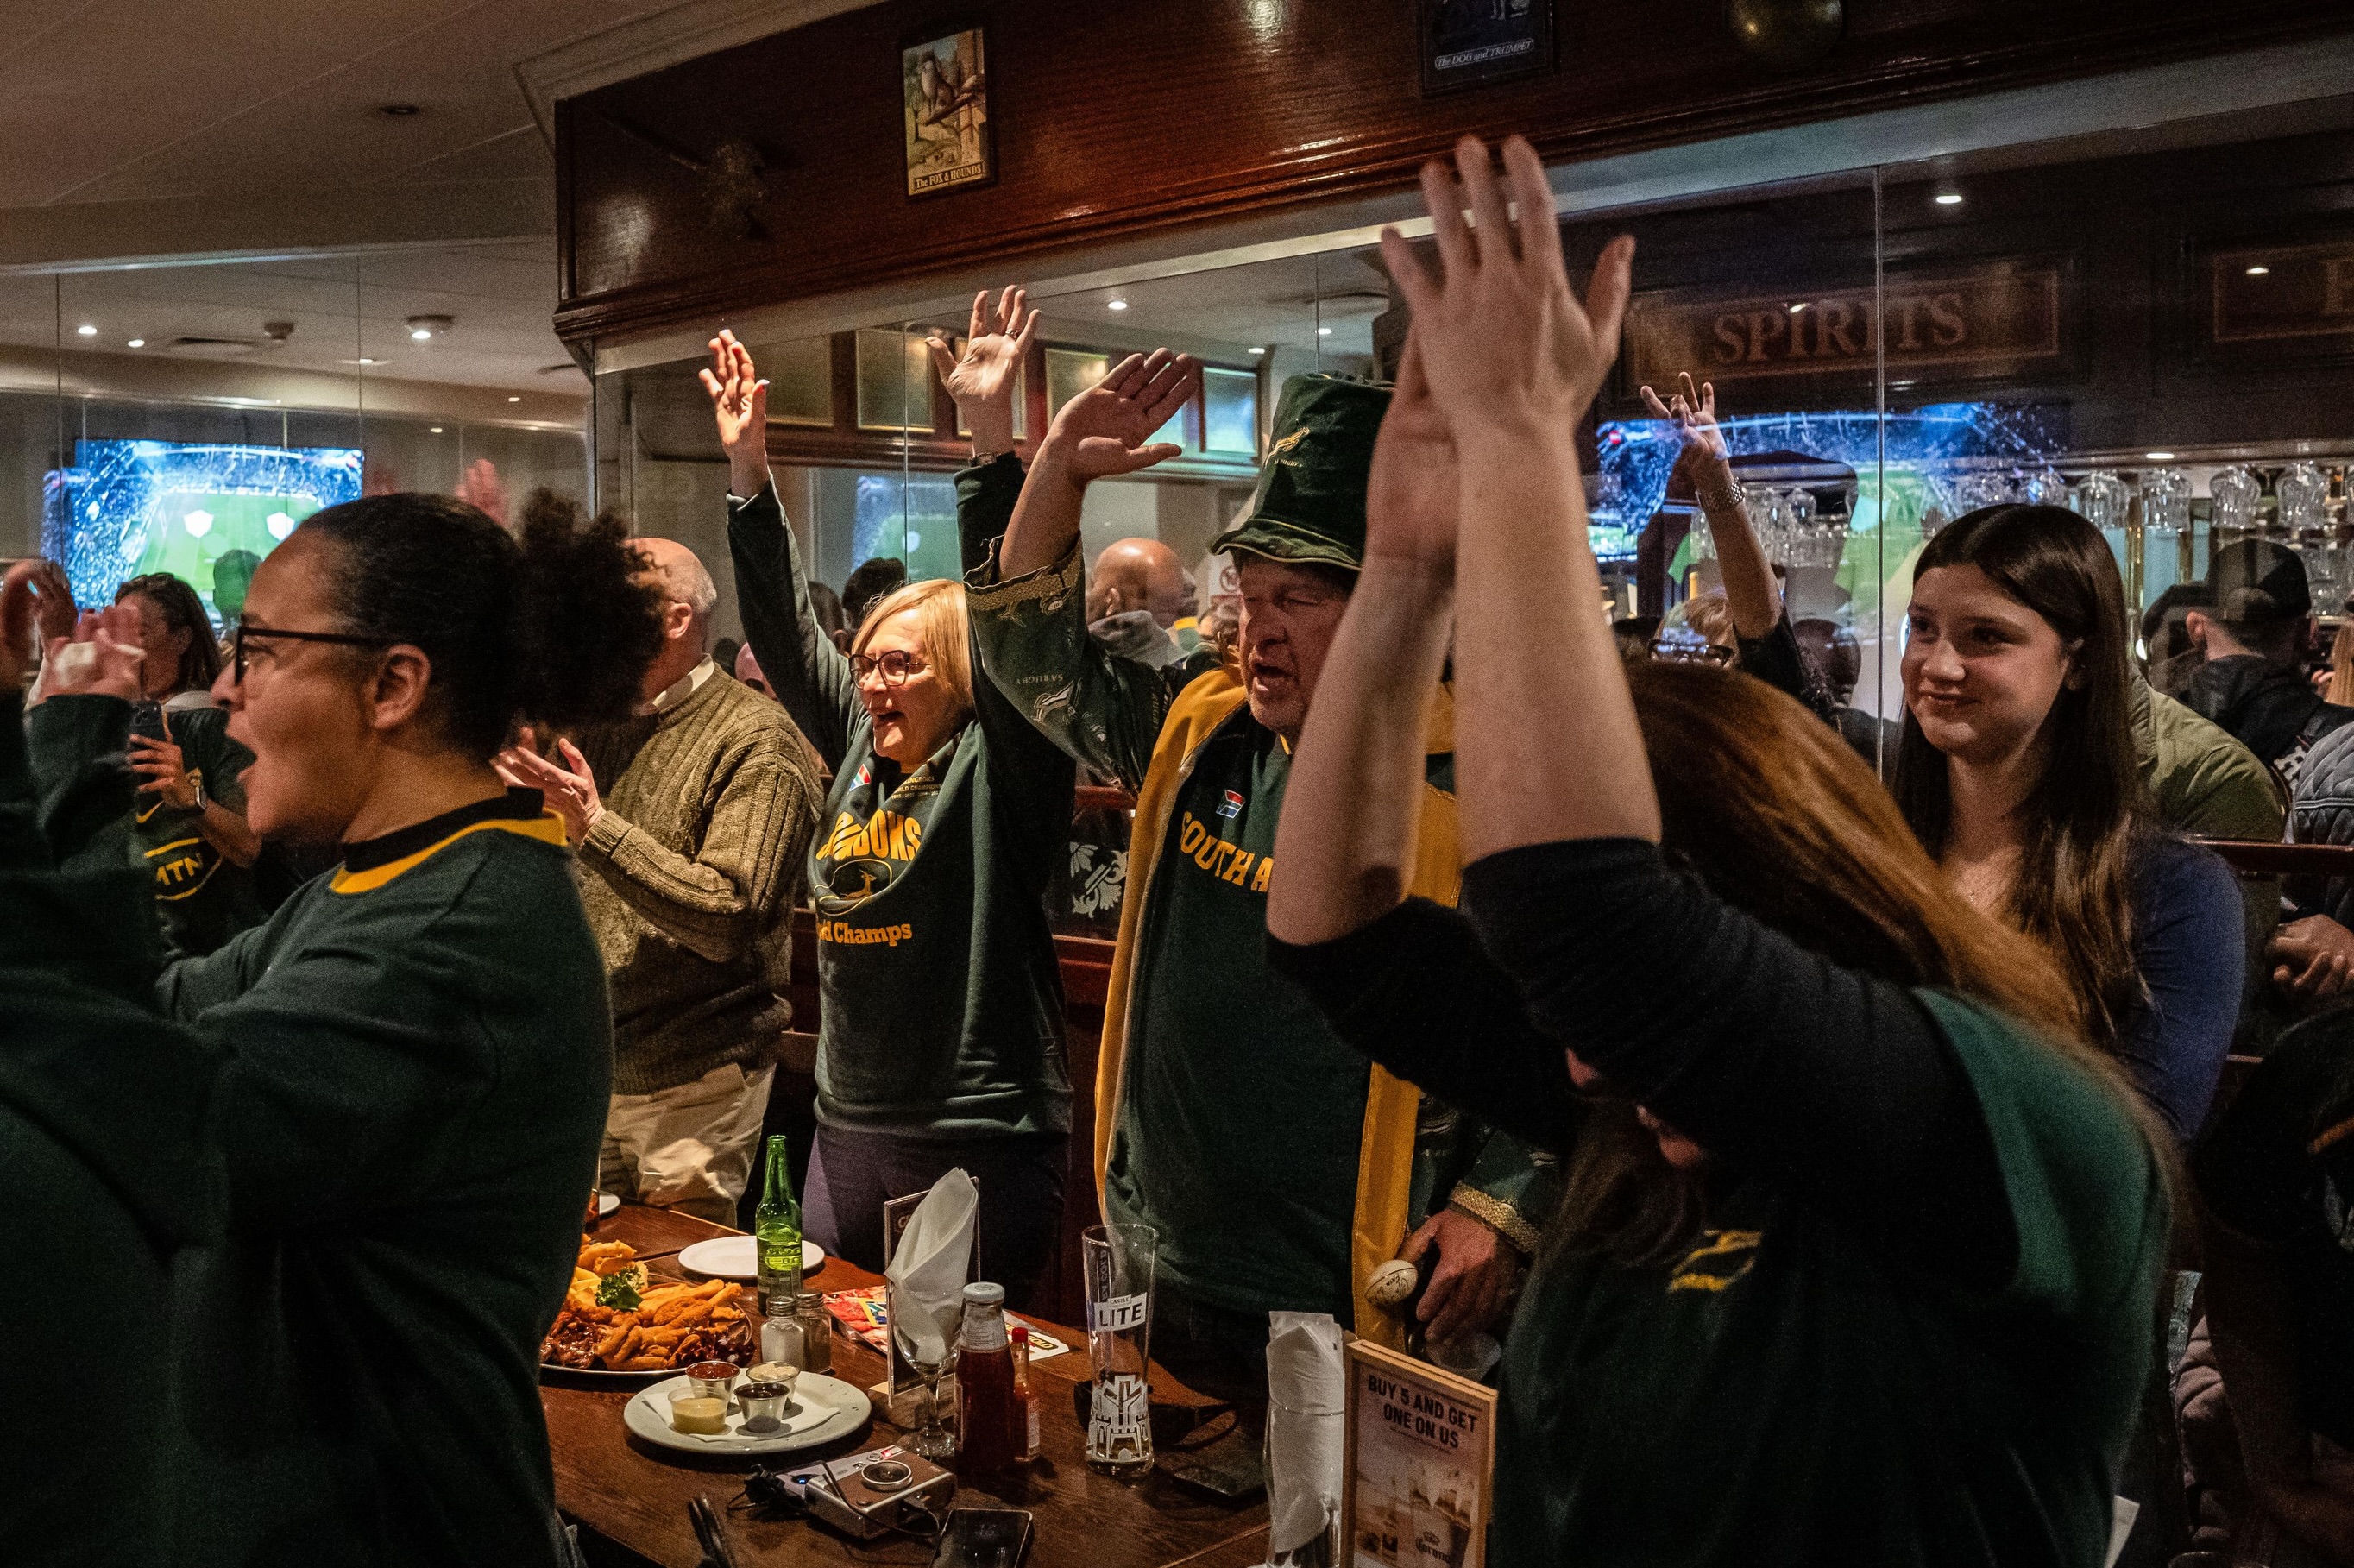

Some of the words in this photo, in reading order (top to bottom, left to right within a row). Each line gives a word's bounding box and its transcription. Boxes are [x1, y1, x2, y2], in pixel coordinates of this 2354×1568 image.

[1452, 52, 1473, 64] DOG
[1489, 41, 1531, 57] TRUMPET
[916, 179, 928, 189] The
[929, 173, 944, 186] FOX
[944, 172, 949, 182] &
[950, 164, 982, 180] HOUNDS
[1714, 293, 1965, 362] SPIRITS
[1016, 675, 1049, 685] RUGBY
[1052, 673, 1064, 682] SA
[1180, 810, 1256, 886] SOUTH
[833, 921, 914, 948] Champs
[1099, 1303, 1142, 1327] LITE
[1368, 1374, 1396, 1400] BUY
[1400, 1387, 1409, 1406] 5
[1413, 1394, 1444, 1419] AND
[1449, 1407, 1477, 1433] GET
[1383, 1403, 1412, 1429] ONE
[1415, 1416, 1435, 1439] ON
[1439, 1426, 1458, 1448] US
